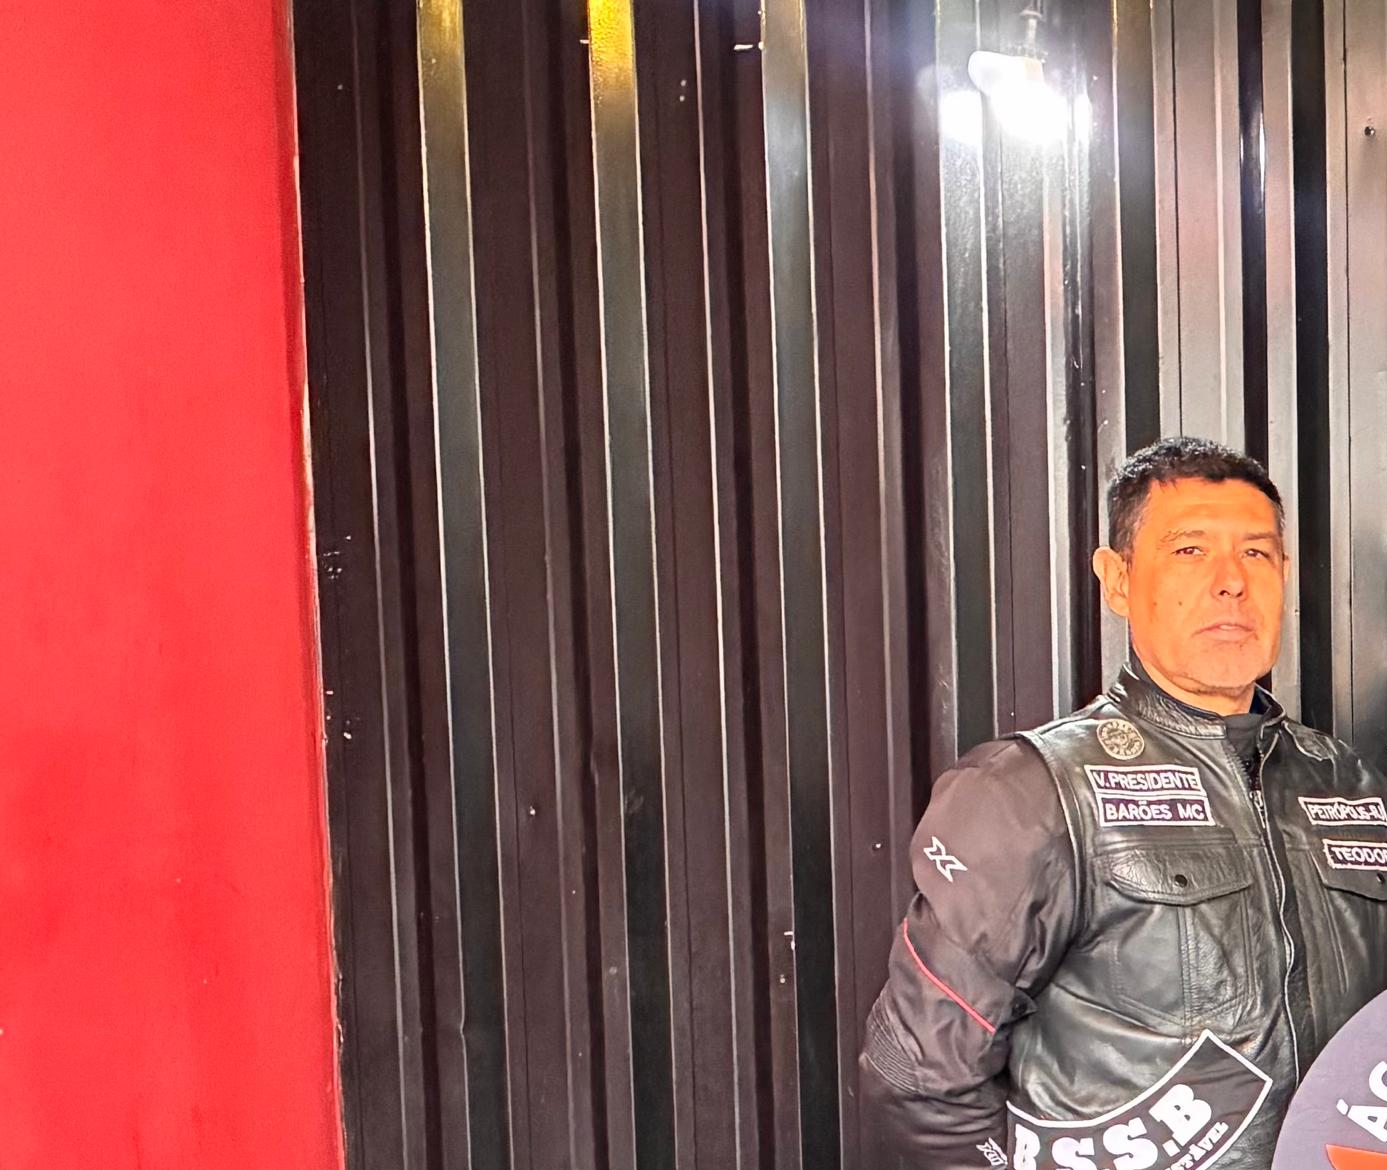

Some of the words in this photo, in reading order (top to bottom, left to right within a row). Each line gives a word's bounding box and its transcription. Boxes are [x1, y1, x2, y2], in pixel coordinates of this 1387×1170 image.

[1092, 771, 1201, 790] V.PRESIDENTE
[1105, 801, 1172, 819] BARÕES
[1177, 803, 1204, 819] MC
